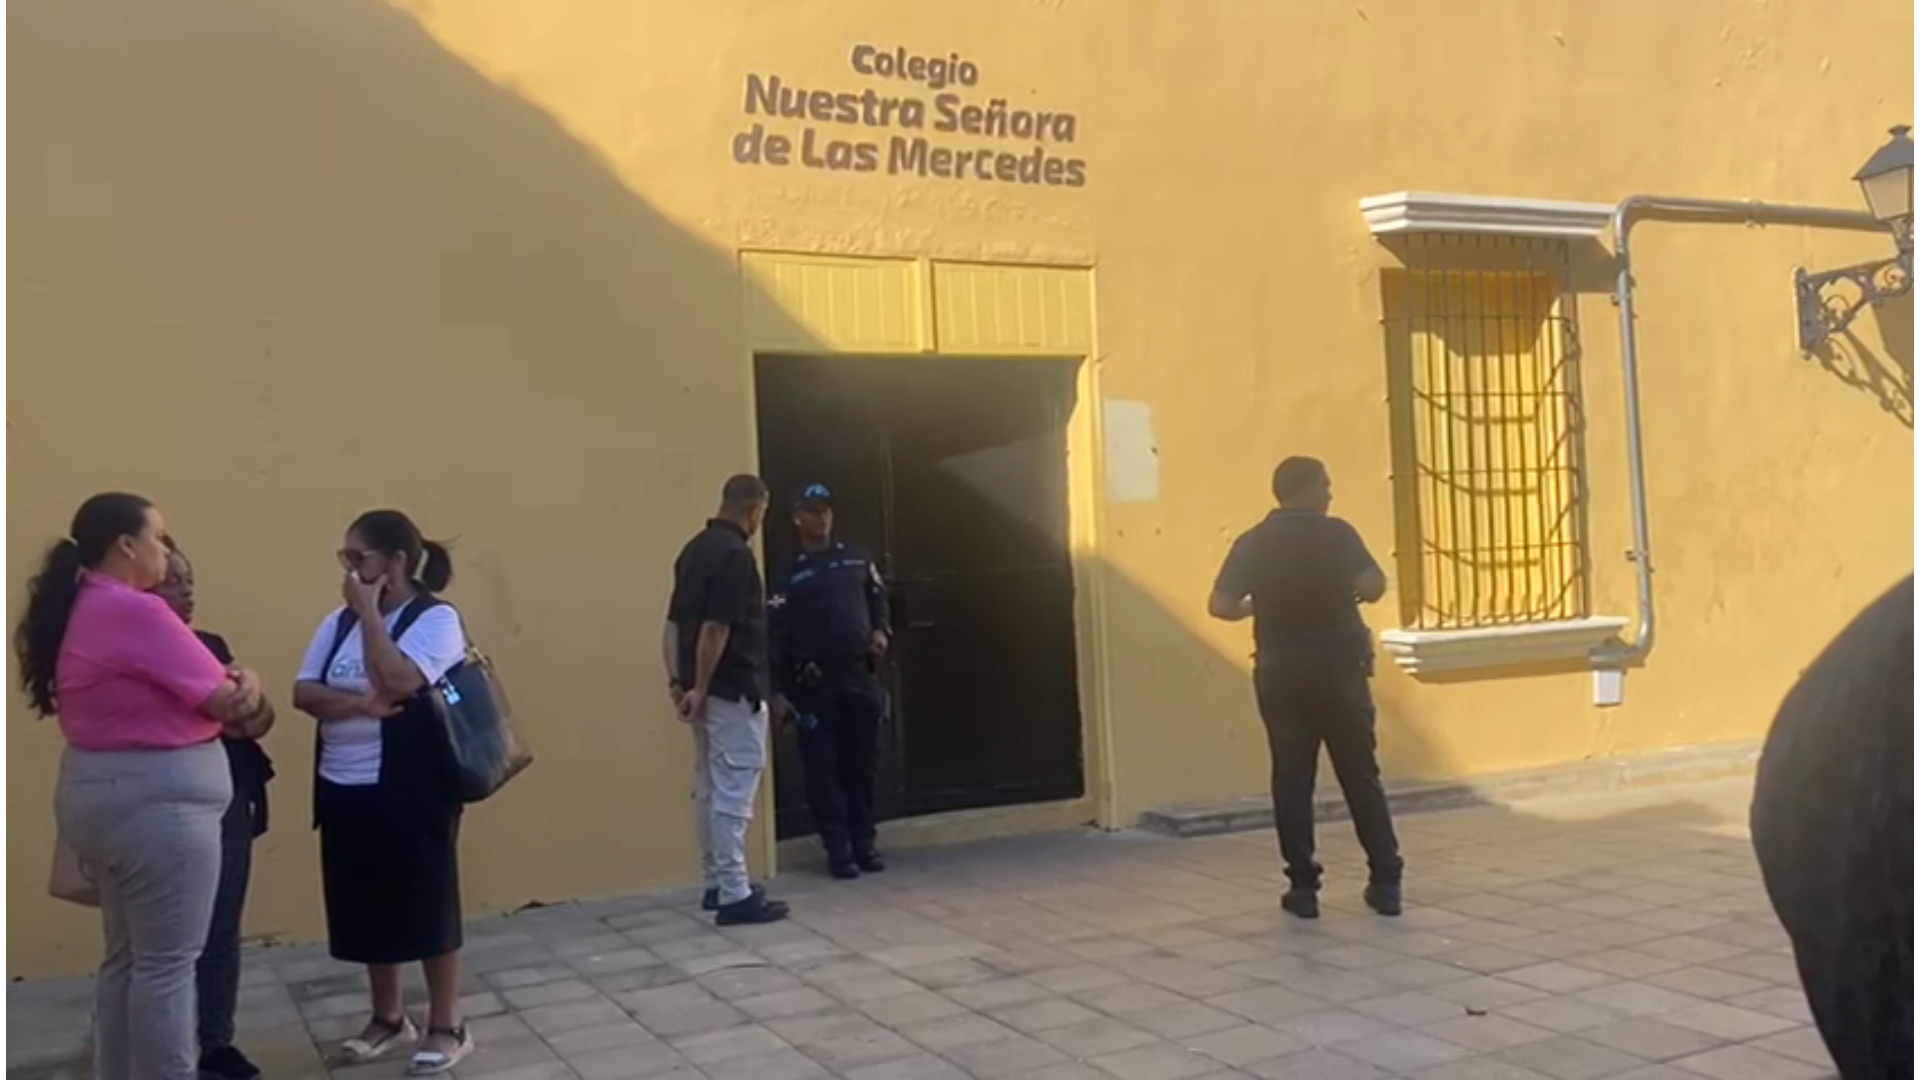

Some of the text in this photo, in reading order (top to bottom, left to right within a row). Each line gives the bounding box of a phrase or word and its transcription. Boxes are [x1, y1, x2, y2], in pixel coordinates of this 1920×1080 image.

[851, 45, 979, 89] Colegio
[745, 73, 1076, 142] Nuestra Señora
[732, 124, 1086, 187] de Las Mercedes
